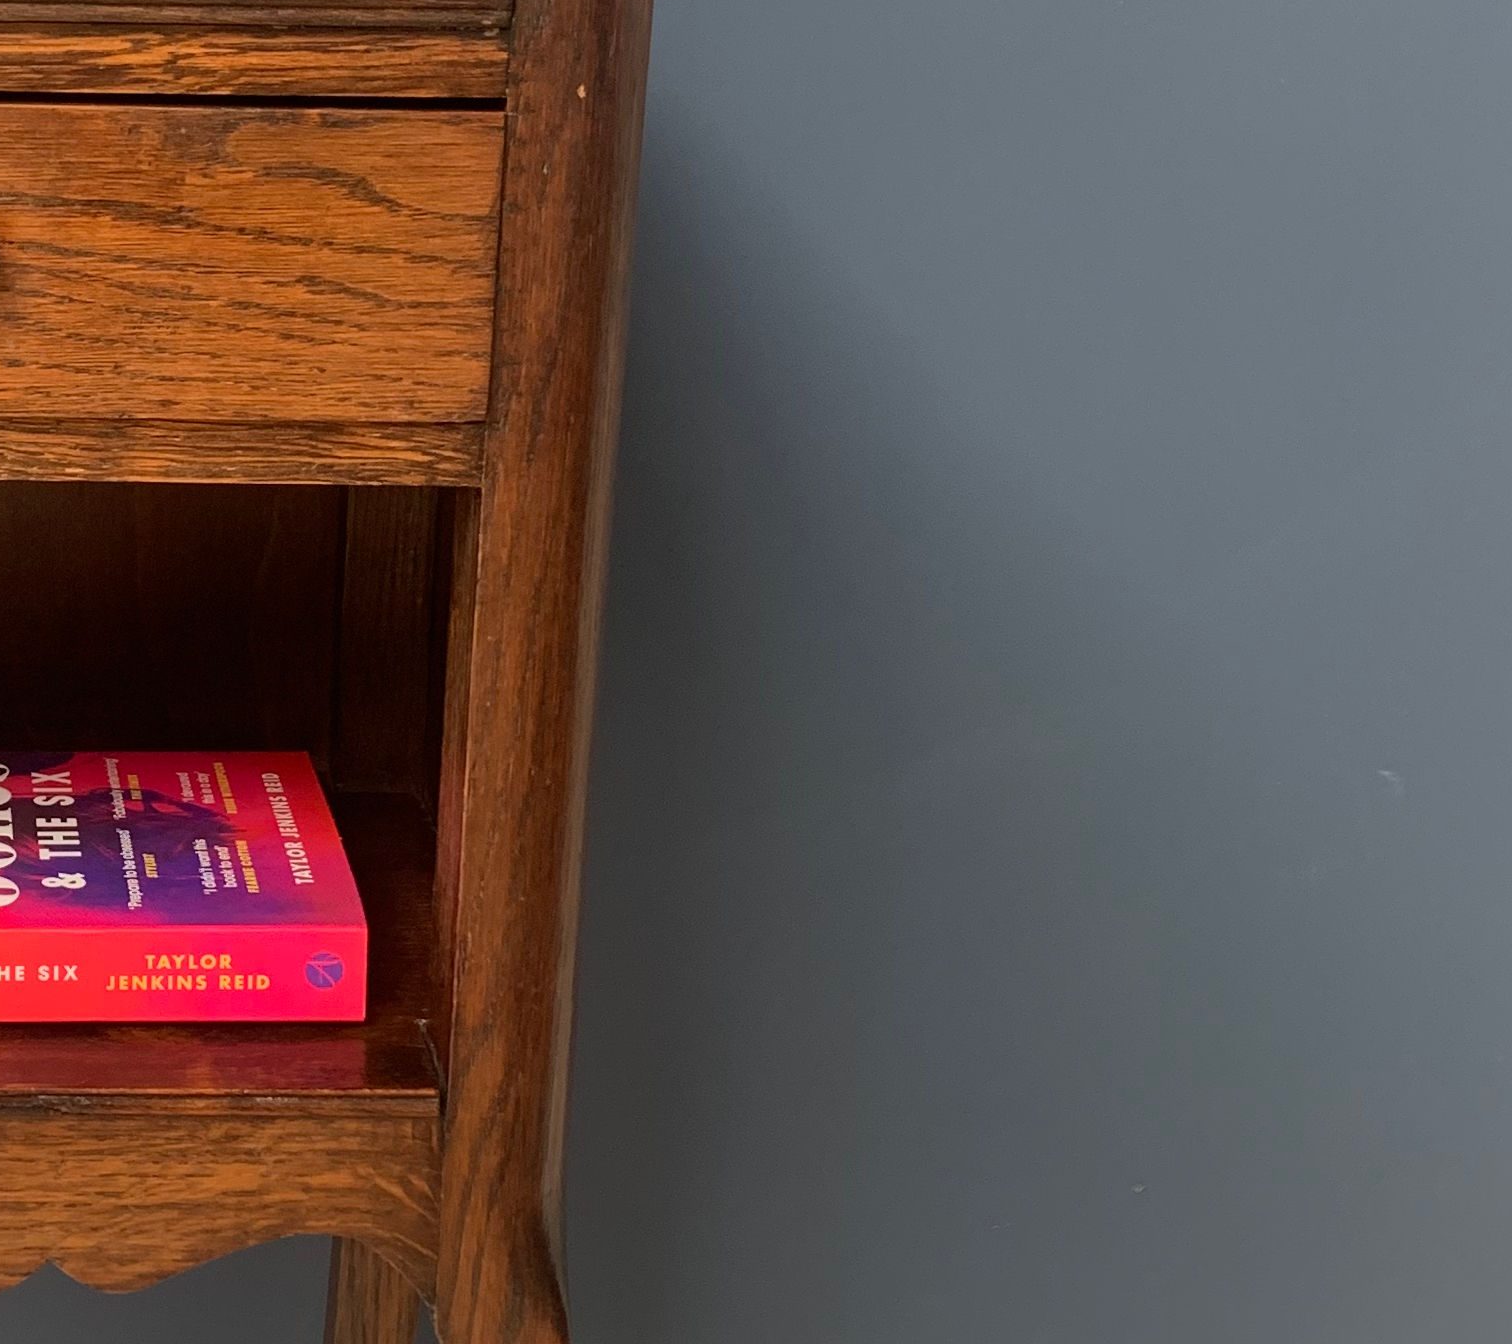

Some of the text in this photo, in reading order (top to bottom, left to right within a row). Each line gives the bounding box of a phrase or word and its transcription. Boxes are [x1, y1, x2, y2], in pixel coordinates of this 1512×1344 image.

[31, 771, 86, 889] & THE SIX
[261, 772, 314, 885] TAYLOR JENKINS REID
[235, 840, 253, 866] COTTON
[122, 859, 136, 870] be
[220, 869, 238, 888] book
[145, 954, 233, 970] TAYLOR
[37, 965, 80, 982] SIX
[106, 974, 271, 991] JENKINS REID
